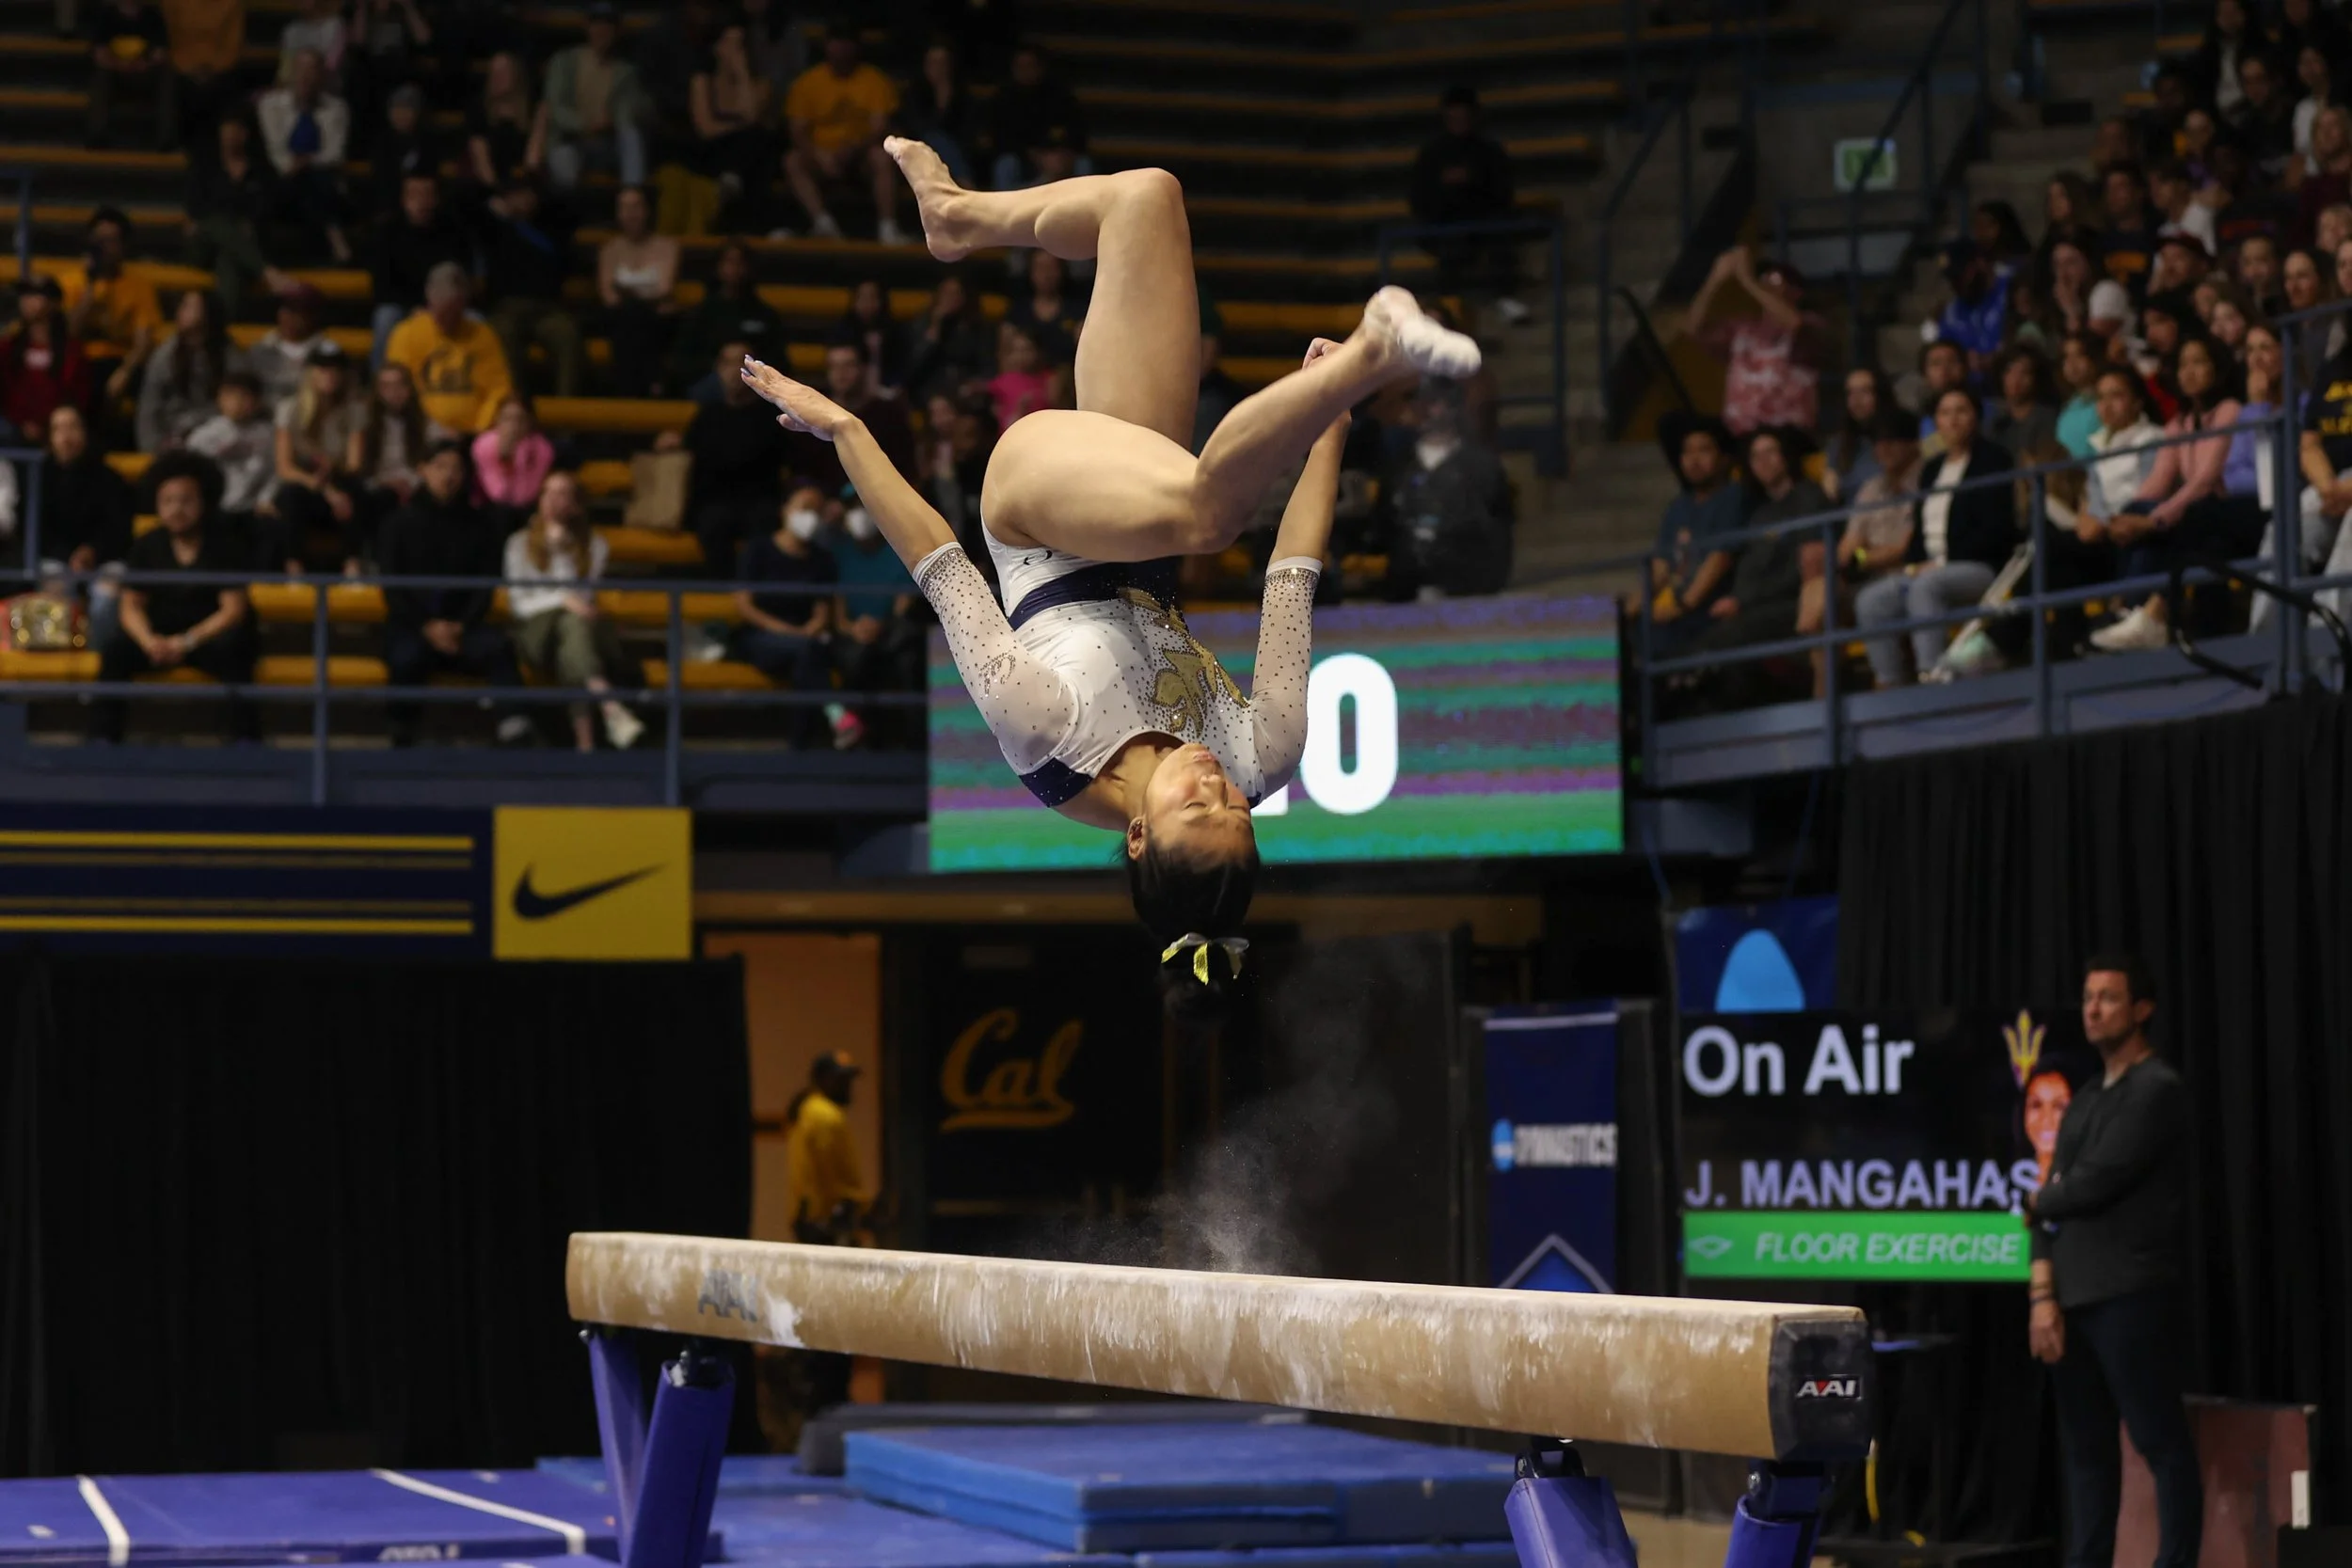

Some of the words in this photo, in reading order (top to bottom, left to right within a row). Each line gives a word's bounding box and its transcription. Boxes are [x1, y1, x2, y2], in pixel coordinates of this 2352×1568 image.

[1251, 653, 1399, 815] 0
[941, 1008, 1083, 1132] Cal
[1683, 1025, 1786, 1097] On
[1804, 1024, 1915, 1095] Air
[1684, 1160, 1725, 1208] J.
[1741, 1159, 2041, 1209] MANGAHAS
[1754, 1232, 1860, 1261] FLOOR
[1865, 1232, 2021, 1263] EXERCISE
